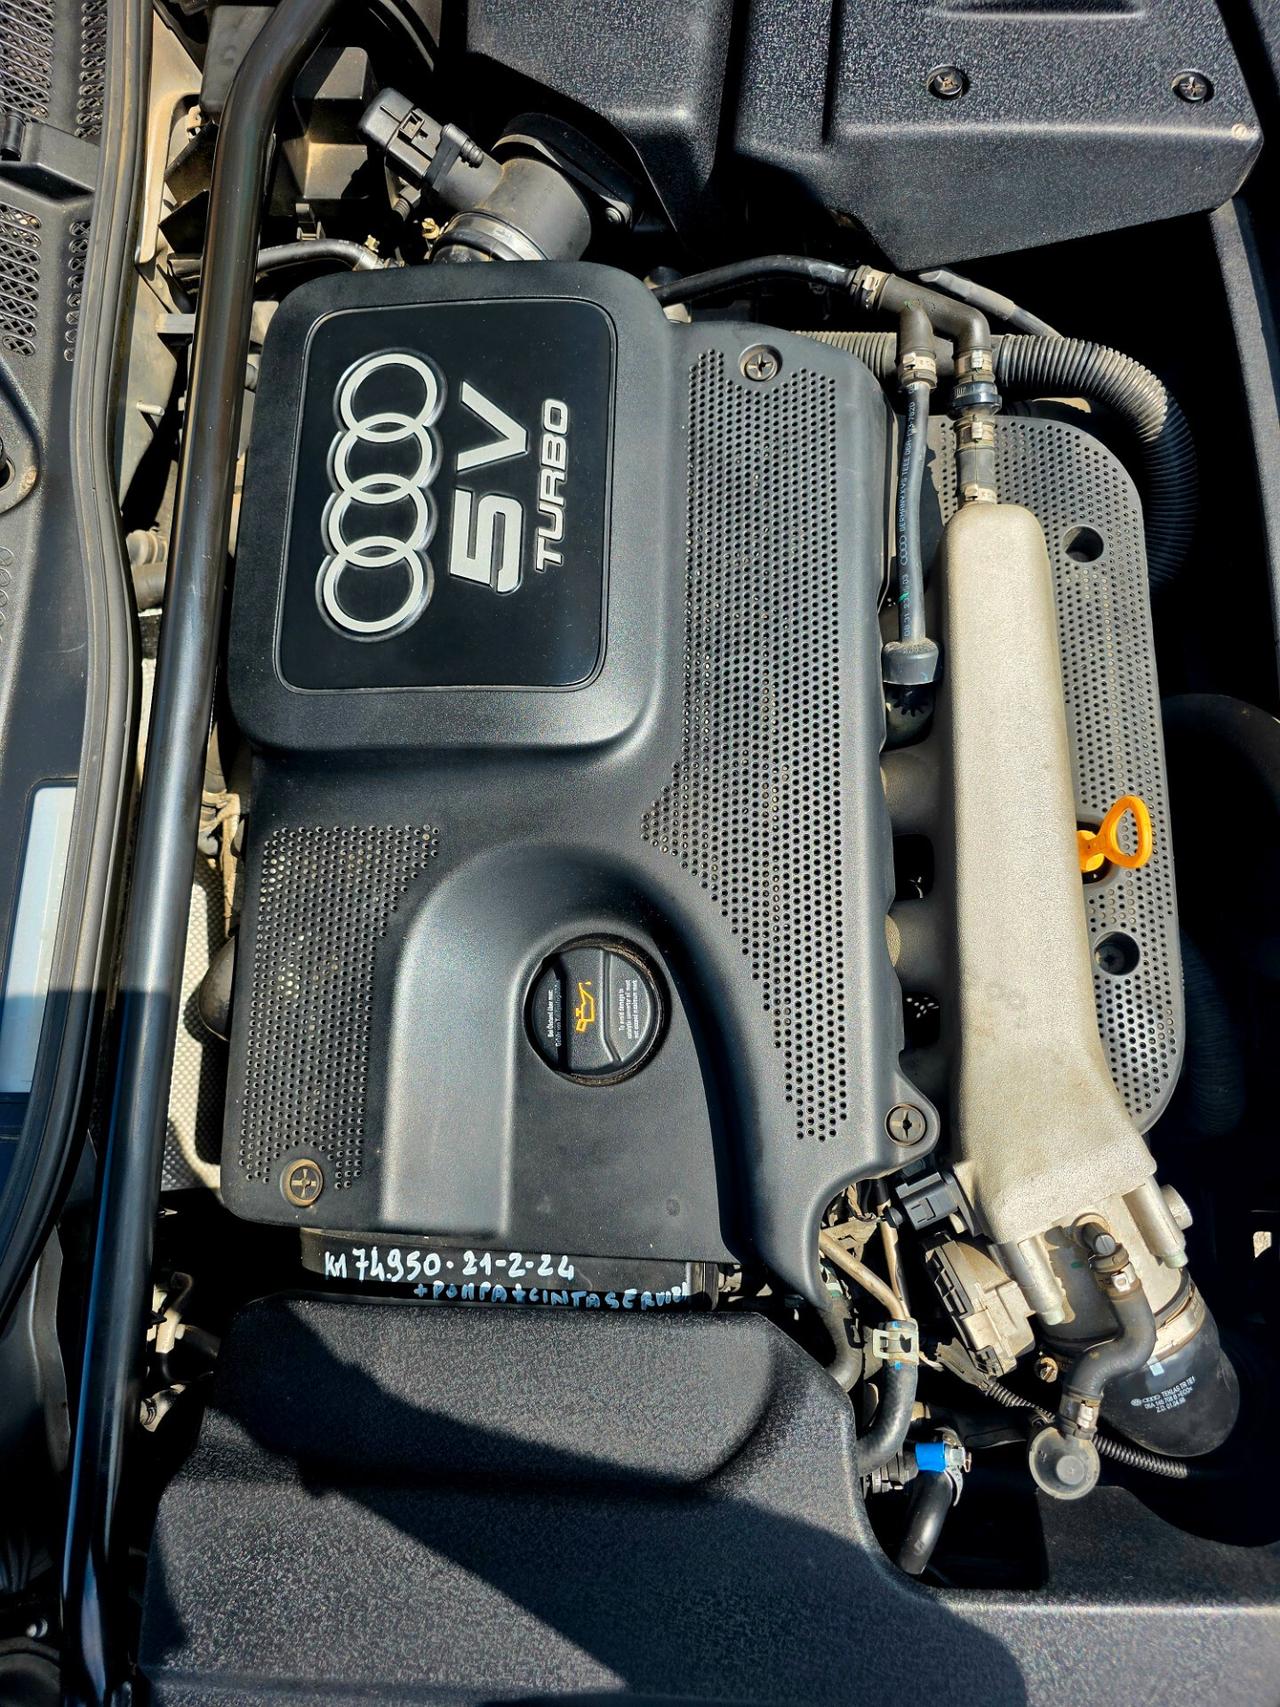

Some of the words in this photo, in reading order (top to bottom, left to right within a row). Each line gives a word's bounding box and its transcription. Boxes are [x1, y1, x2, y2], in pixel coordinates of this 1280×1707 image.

[449, 380, 528, 593] 5V
[535, 398, 569, 572] TURBO
[462, 1250, 575, 1281] 21-2-24
